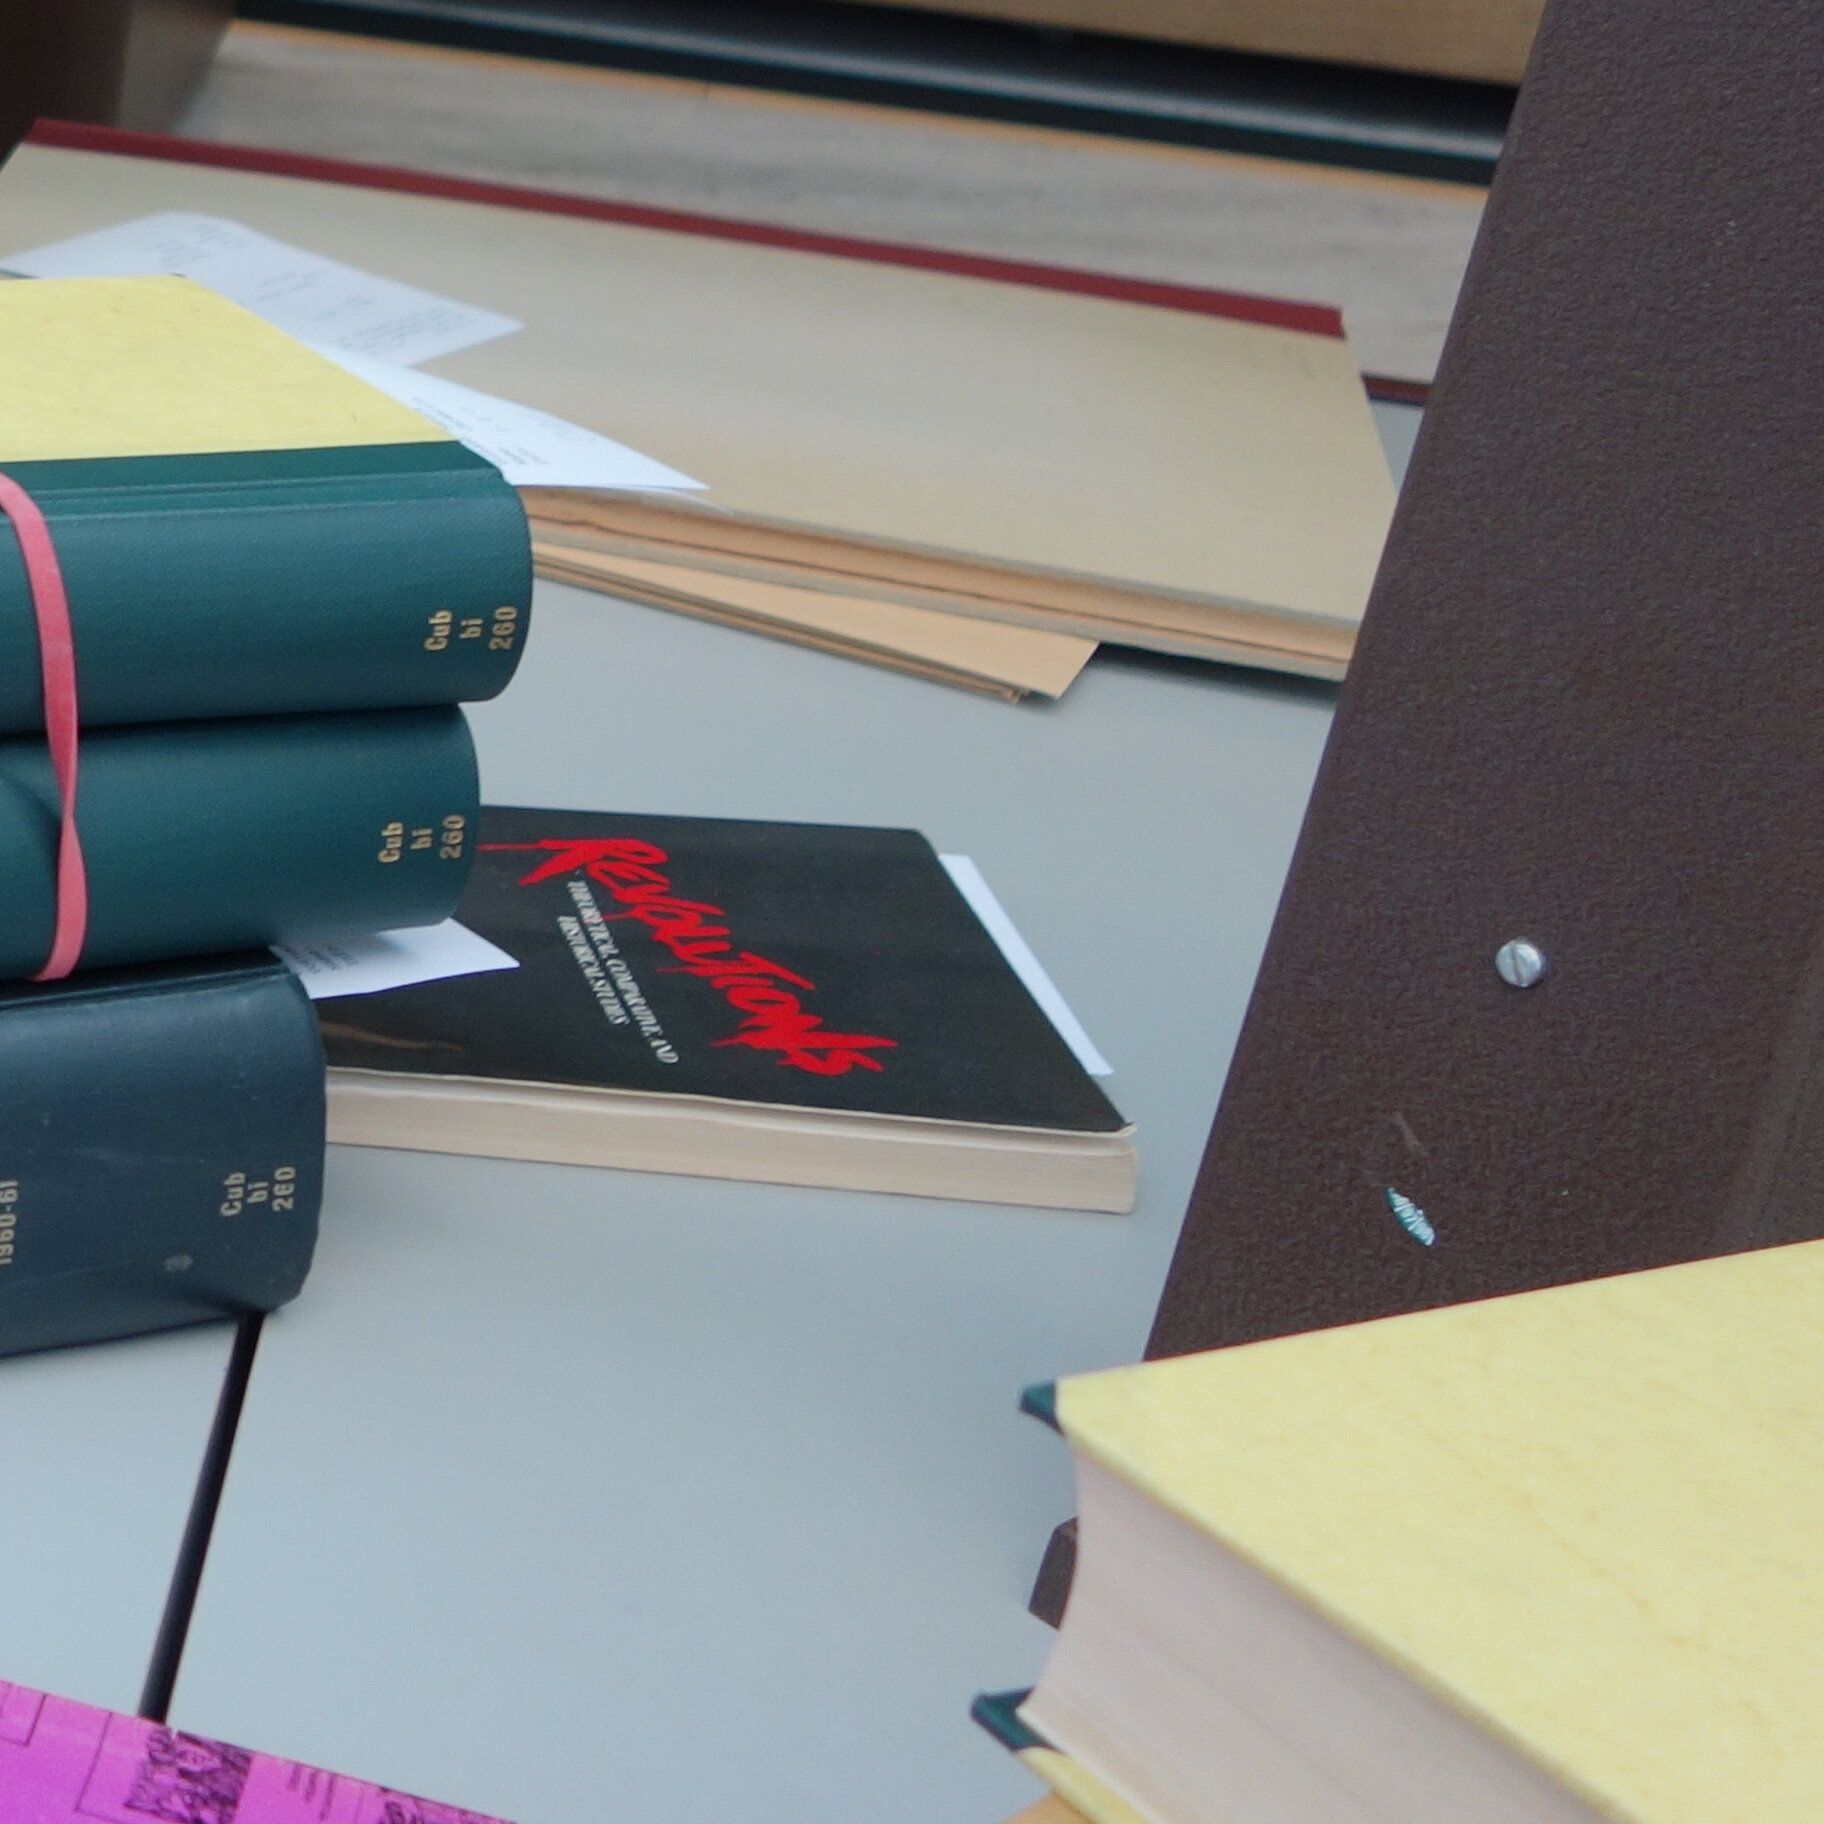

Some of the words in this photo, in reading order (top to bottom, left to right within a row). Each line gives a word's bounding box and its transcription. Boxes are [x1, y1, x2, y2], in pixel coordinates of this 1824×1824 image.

[424, 609, 452, 651] Cub
[459, 617, 483, 639] bi
[489, 606, 518, 650] 260
[378, 822, 403, 863] Cub
[410, 828, 433, 850] bi
[440, 815, 465, 859] 260
[219, 1170, 245, 1218] Cub
[246, 1179, 269, 1205] bi
[272, 1165, 296, 1213] 260
